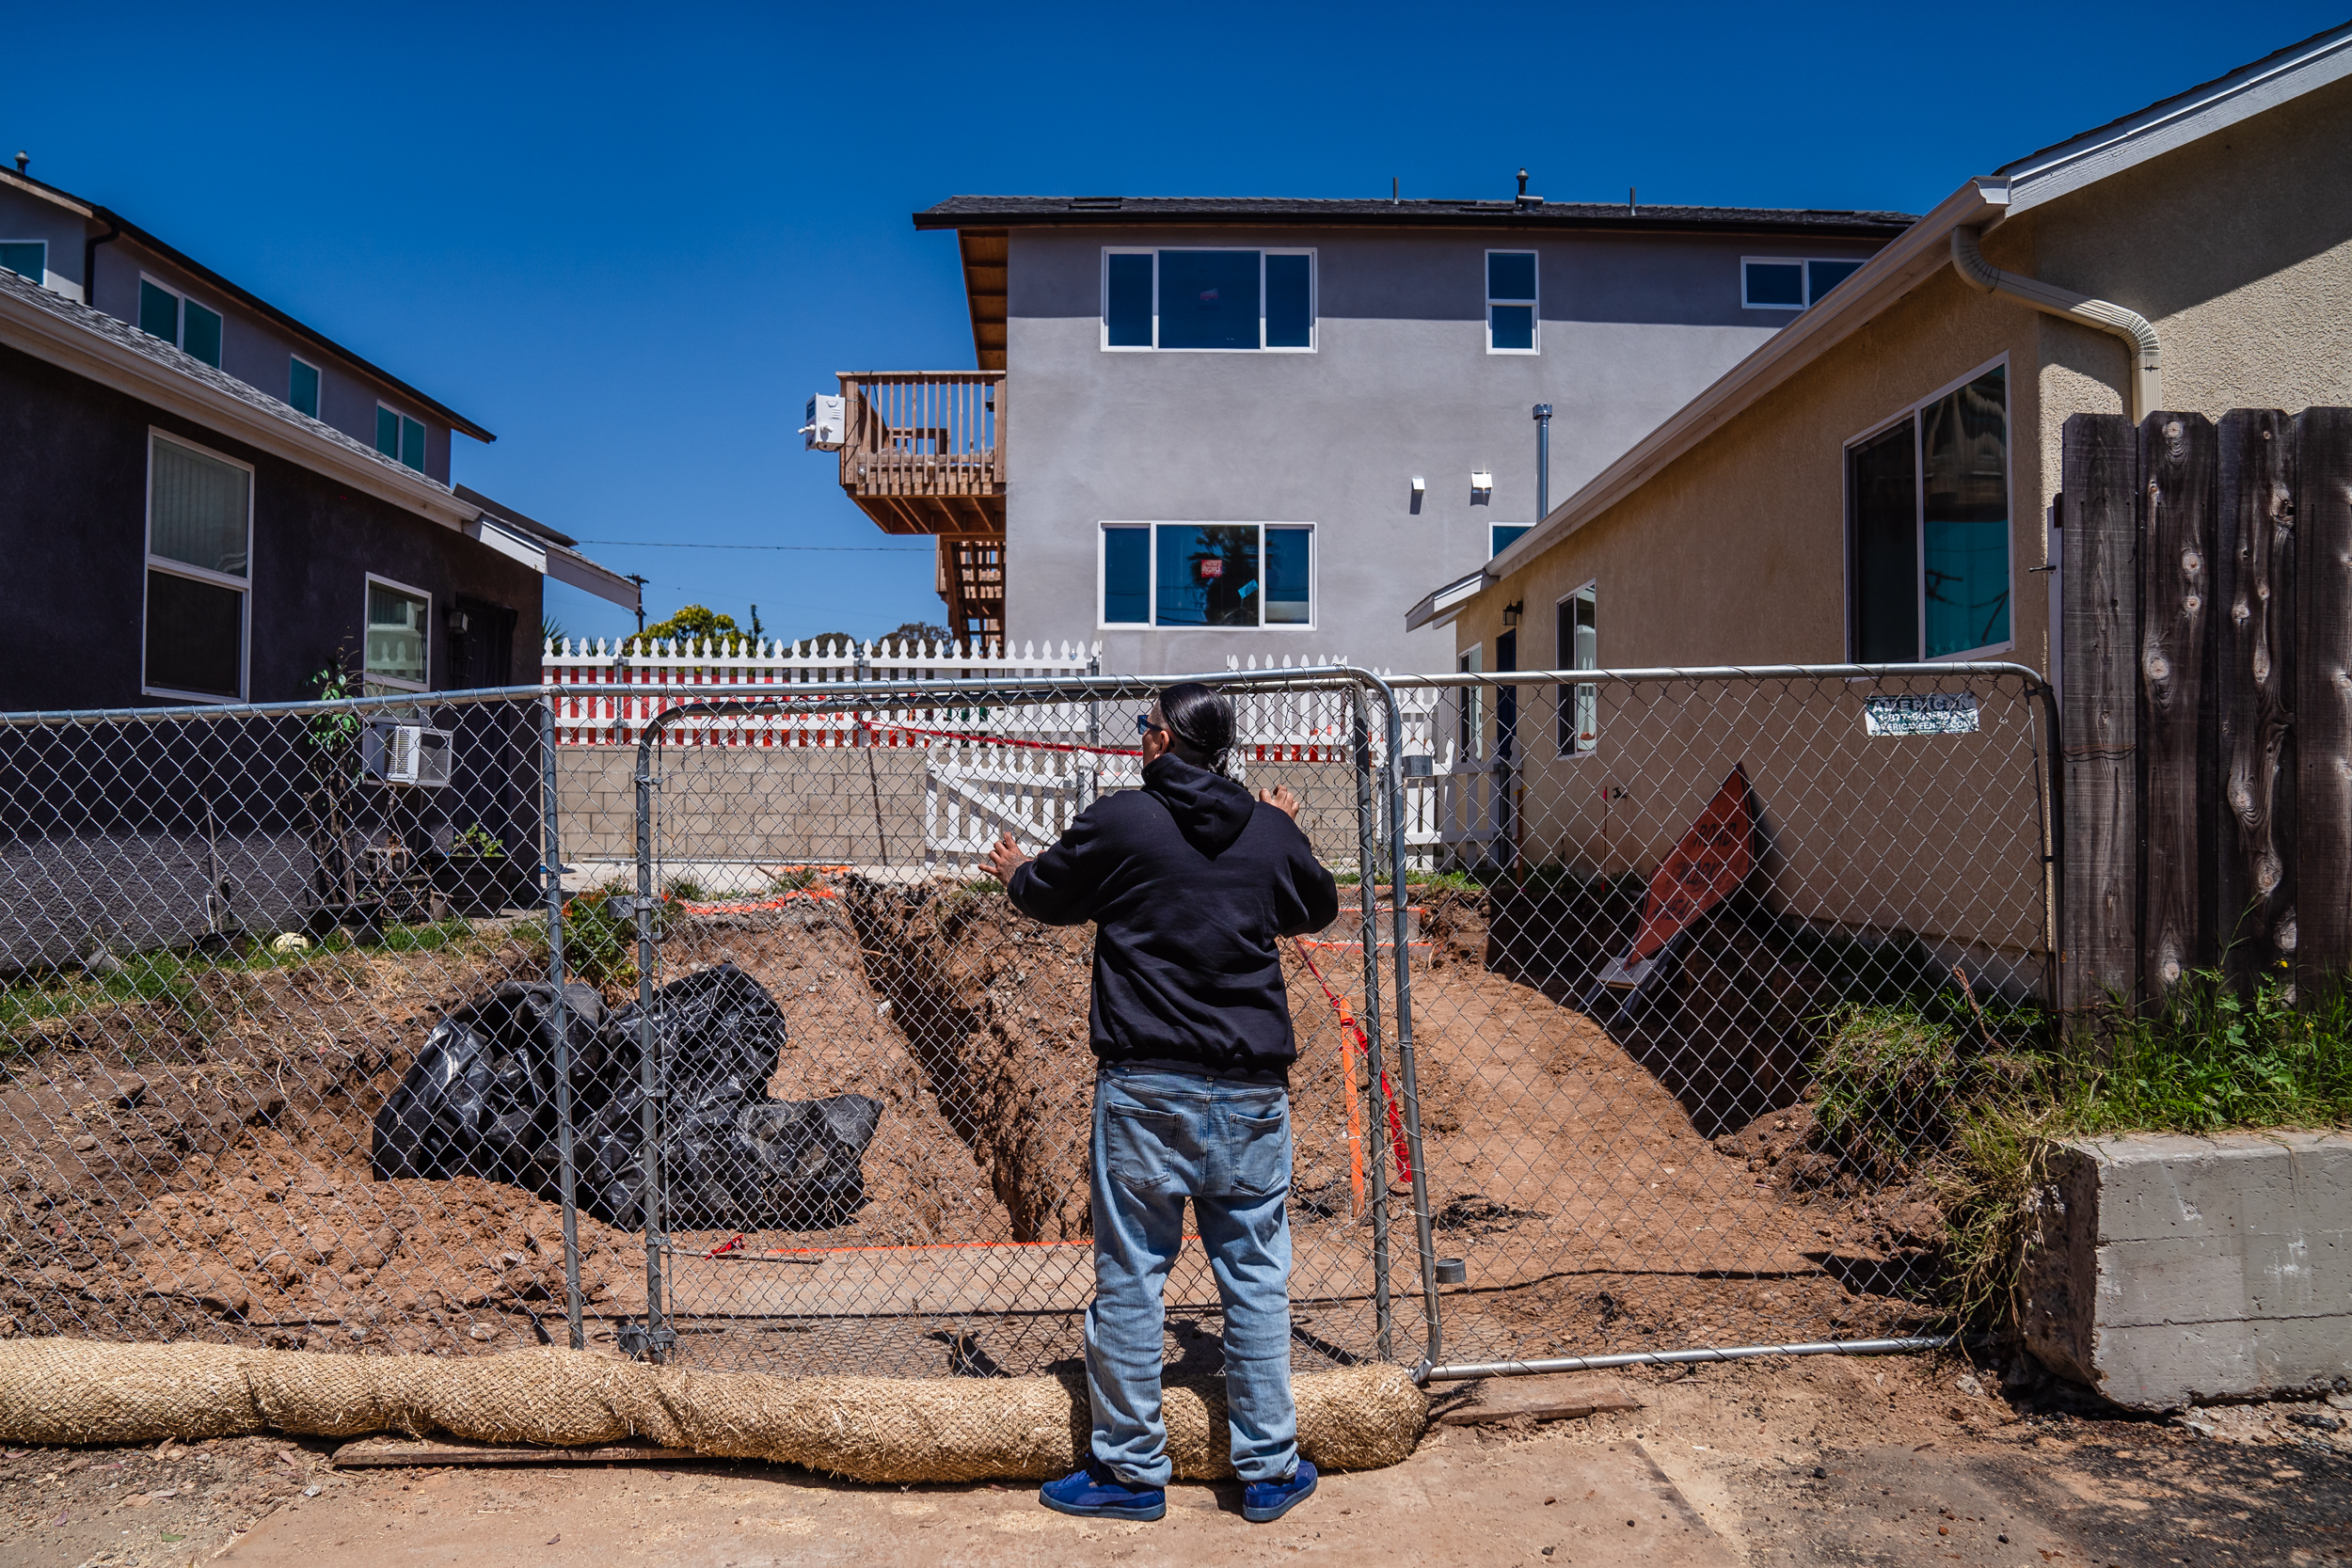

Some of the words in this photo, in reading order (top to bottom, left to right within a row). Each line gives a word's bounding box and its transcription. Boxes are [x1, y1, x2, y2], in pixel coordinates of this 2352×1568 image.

[1872, 699, 1970, 712] AMERICAN
[1692, 822, 1737, 847] ROAD
[1677, 861, 1722, 885] WORK
